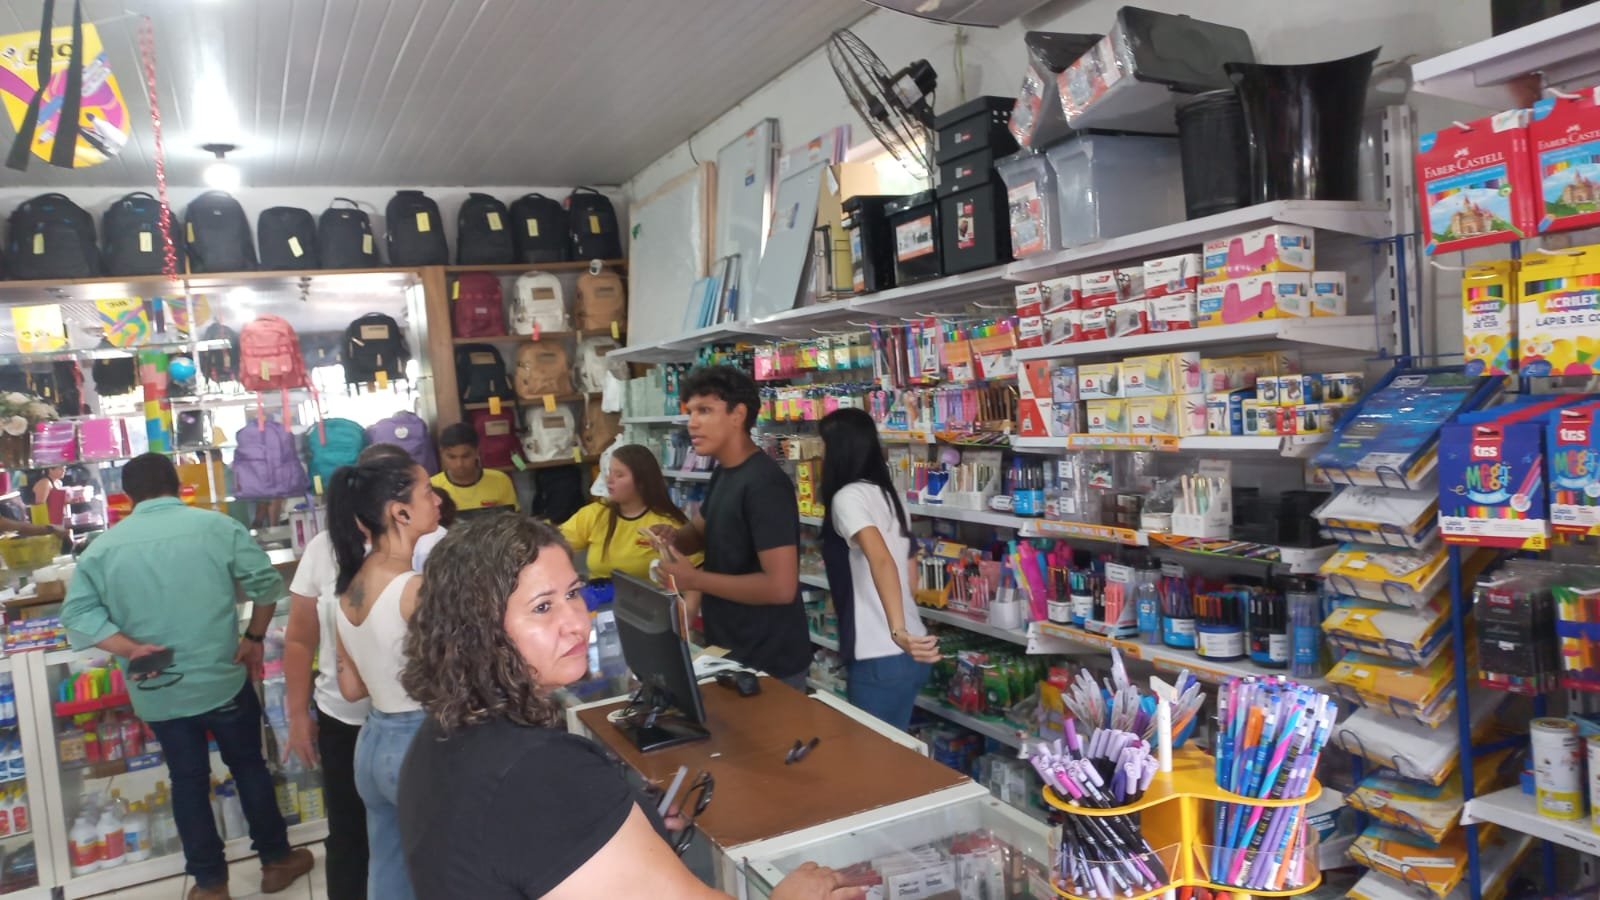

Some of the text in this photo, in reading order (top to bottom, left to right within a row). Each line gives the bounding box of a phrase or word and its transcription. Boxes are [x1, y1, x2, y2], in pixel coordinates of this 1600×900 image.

[28, 43, 74, 62] BC
[1424, 151, 1505, 179] FABER-CASTELL
[1544, 294, 1598, 309] ACRILEX
[1570, 315, 1585, 324] DE
